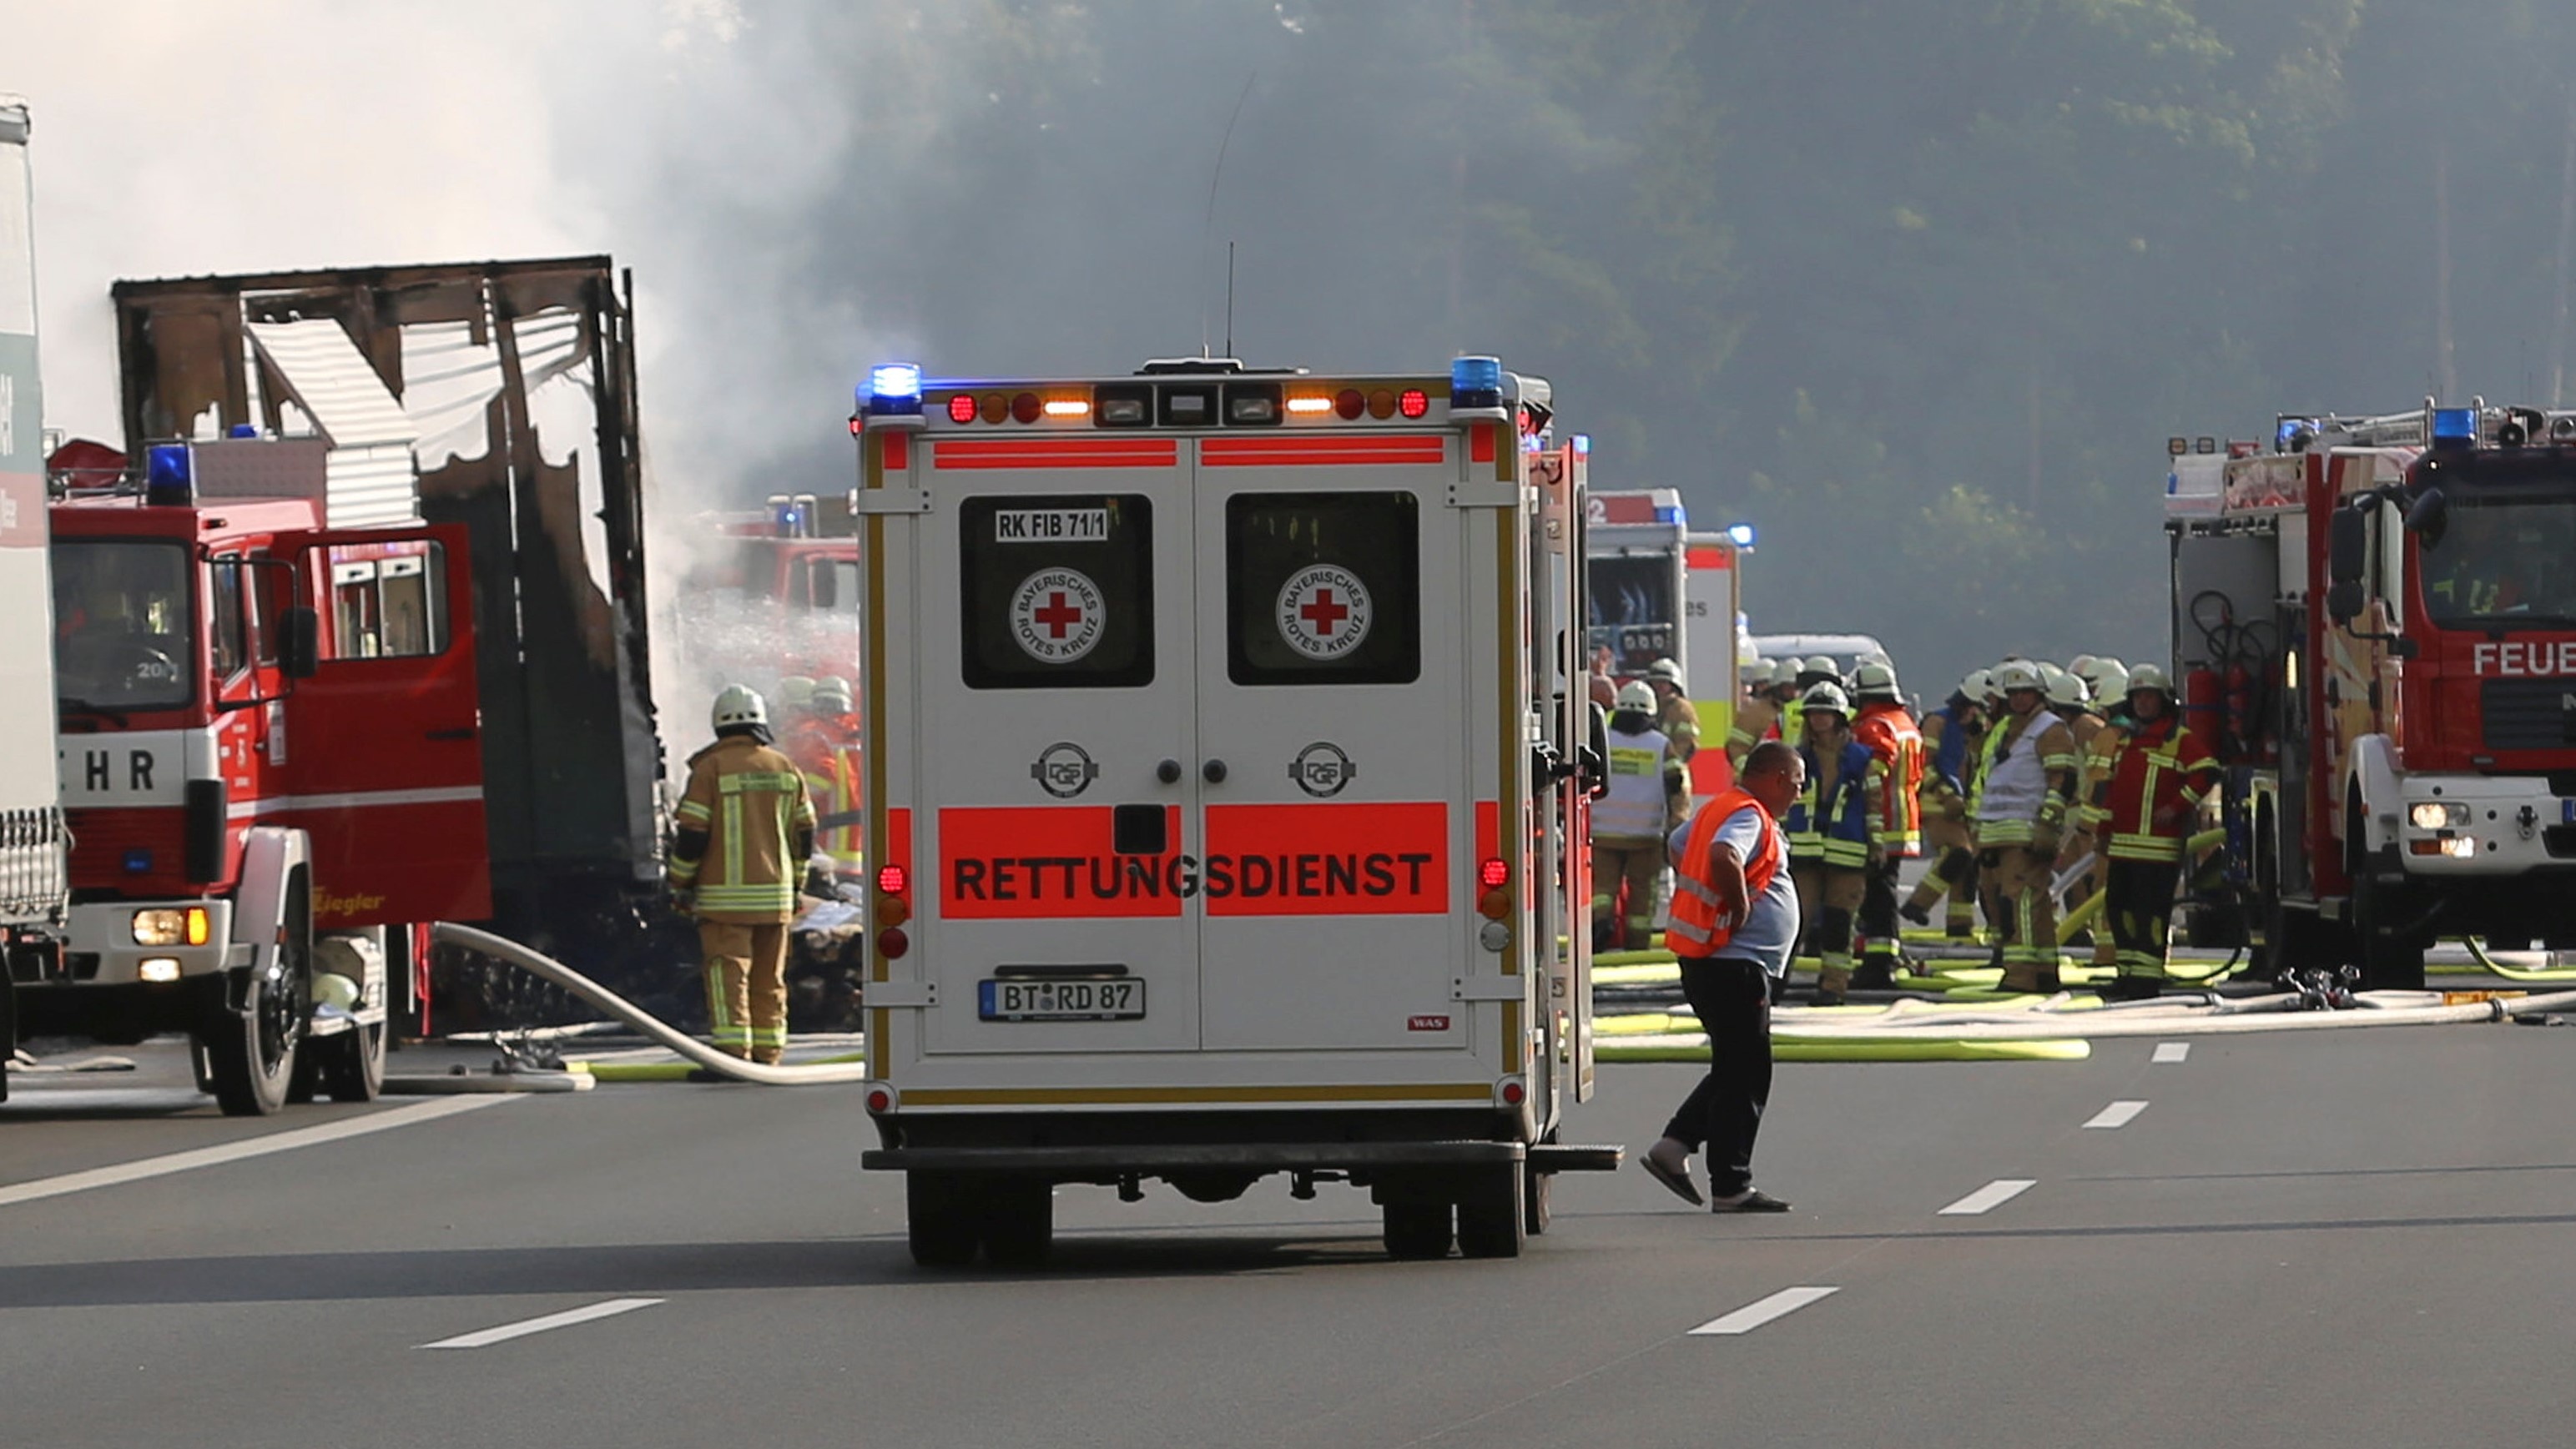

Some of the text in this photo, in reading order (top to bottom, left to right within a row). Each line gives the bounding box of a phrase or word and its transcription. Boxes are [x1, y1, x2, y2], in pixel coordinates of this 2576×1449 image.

[999, 512, 1105, 537] RK FIB 71/1
[1018, 574, 1097, 612] BAYERISCHES
[1284, 571, 1364, 608] BAYERISCHES
[1017, 617, 1098, 656] ROTES KREUZ
[1284, 614, 1364, 652] ROTES KREUZ
[955, 853, 1433, 901] RETTUNGSDIENST
[1004, 984, 1132, 1010] BT RD 87
[1414, 1018, 1443, 1028] WAS
